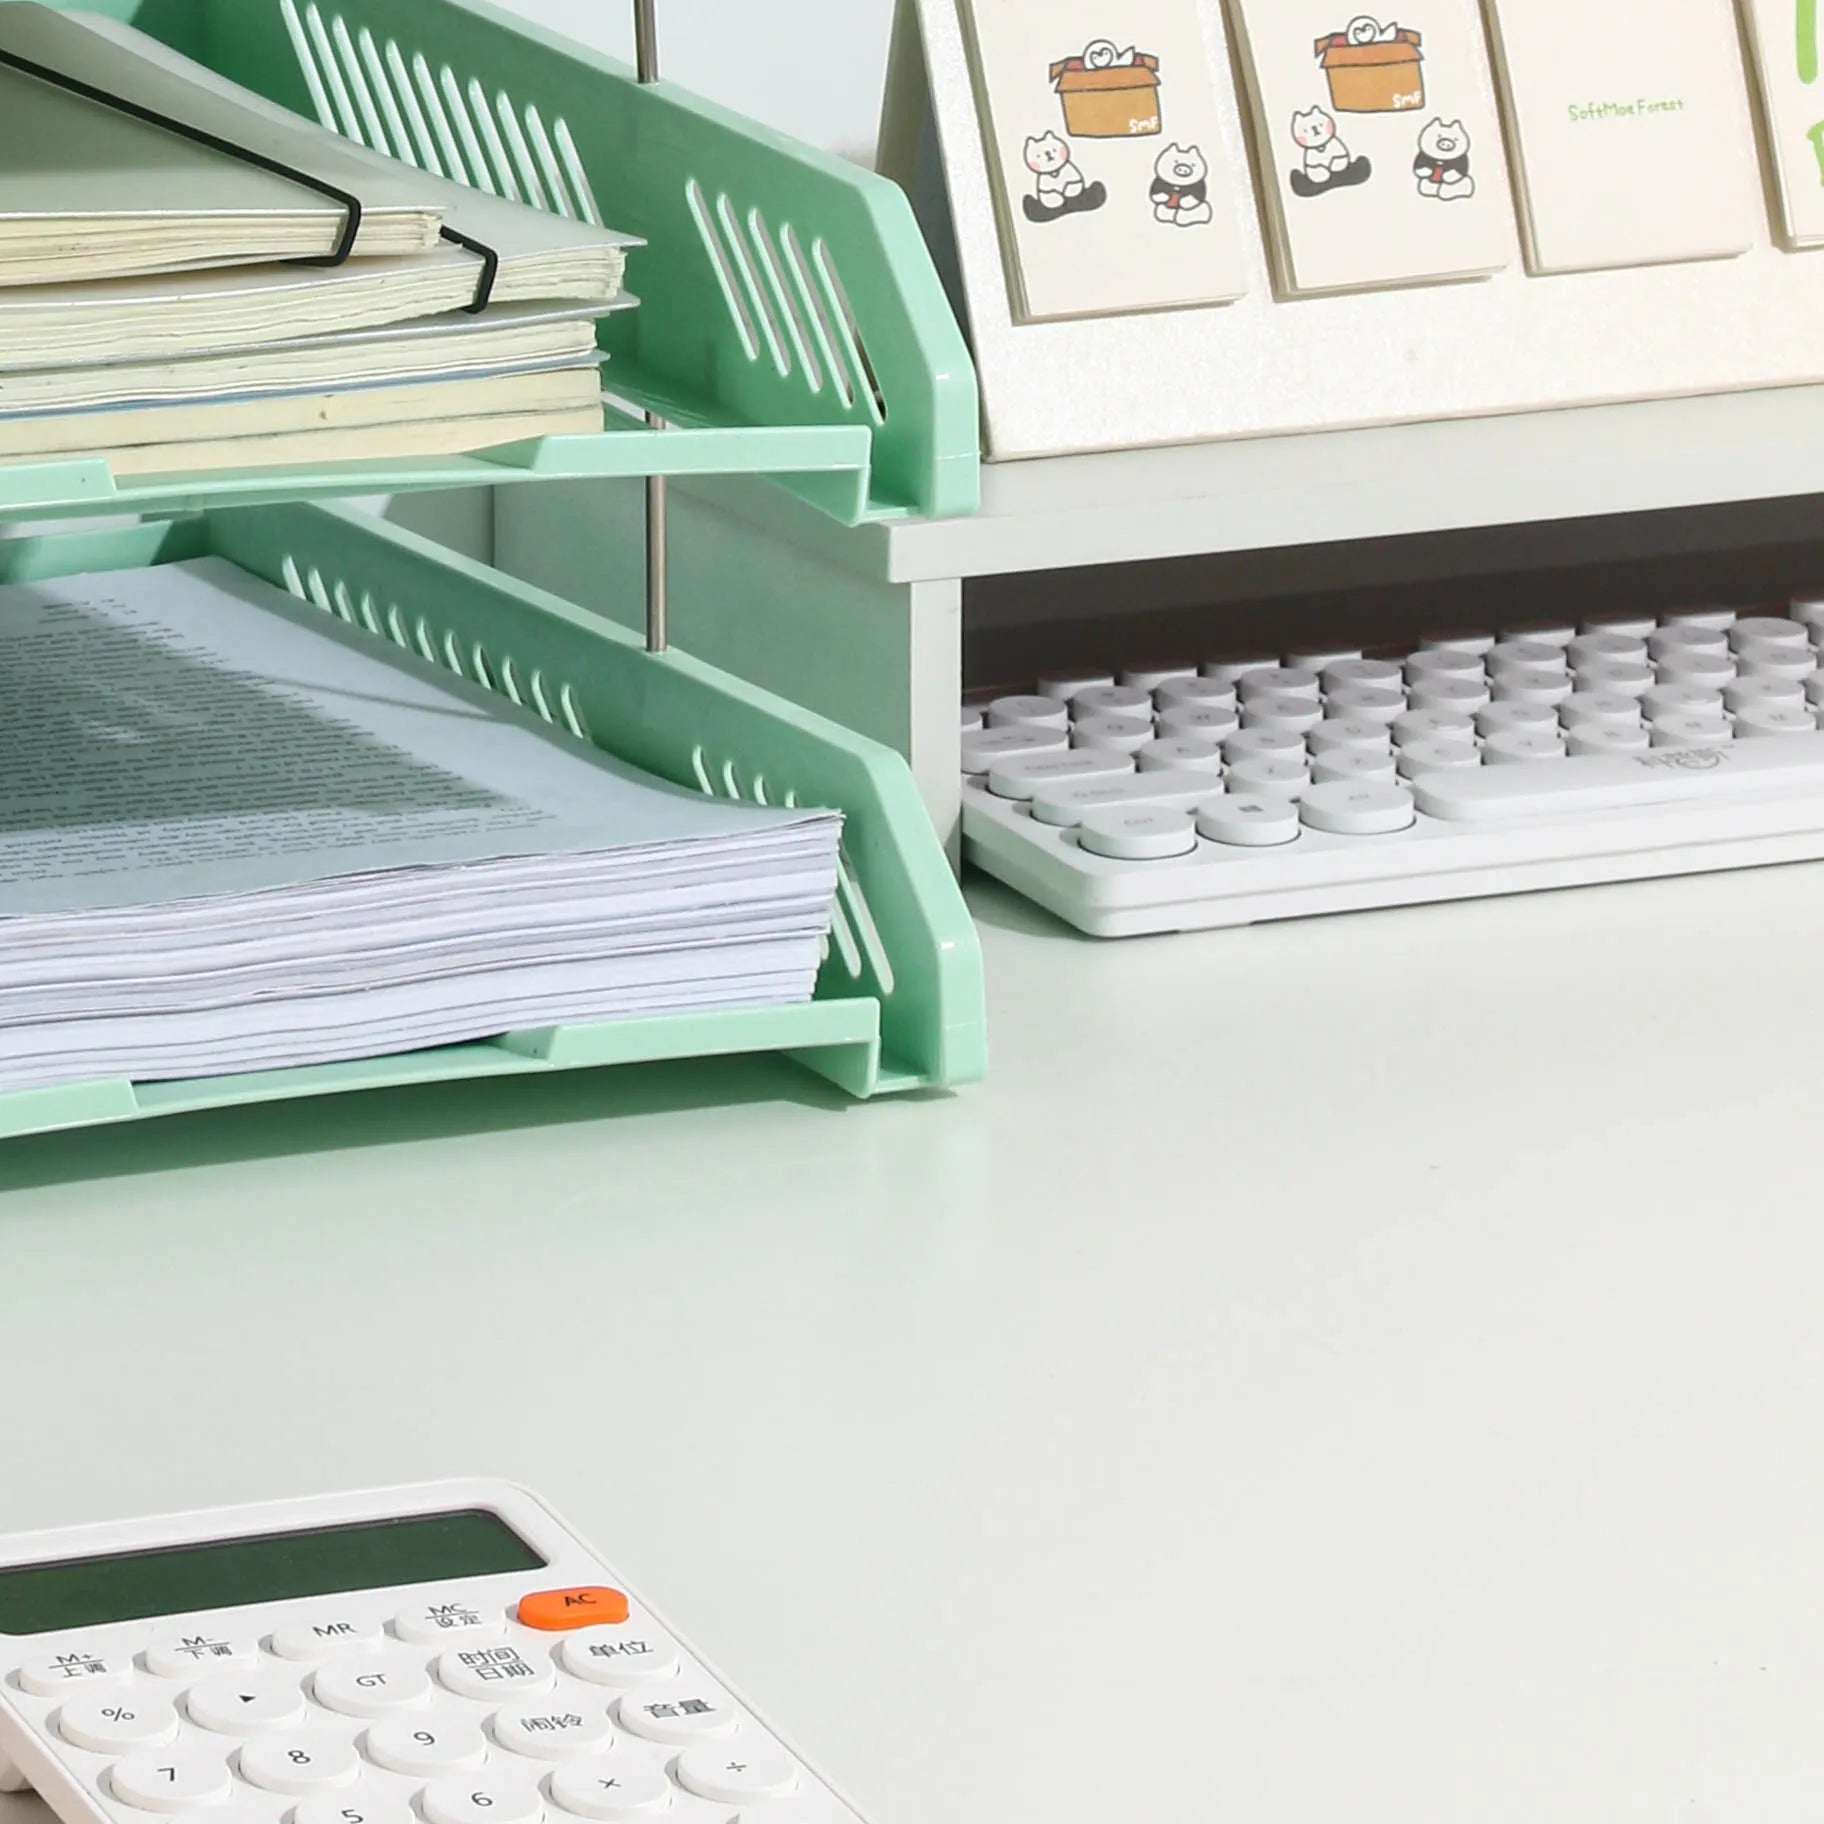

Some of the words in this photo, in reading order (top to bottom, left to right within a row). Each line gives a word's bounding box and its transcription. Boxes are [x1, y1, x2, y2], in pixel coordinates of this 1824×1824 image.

[426, 1602, 468, 1616] MC
[563, 1593, 597, 1607] AC
[312, 1622, 358, 1638] MR
[456, 1646, 520, 1665] 时间
[588, 1640, 656, 1659] 单位
[355, 1671, 388, 1689] GT
[474, 1663, 536, 1682] 日期
[100, 1705, 136, 1723] %
[642, 1696, 718, 1720] 音量
[520, 1711, 585, 1733] 闹铃
[413, 1729, 437, 1748] 9
[287, 1748, 312, 1765] 8
[156, 1765, 177, 1783] 7
[470, 1790, 495, 1808] 6
[340, 1808, 365, 1824] 5
